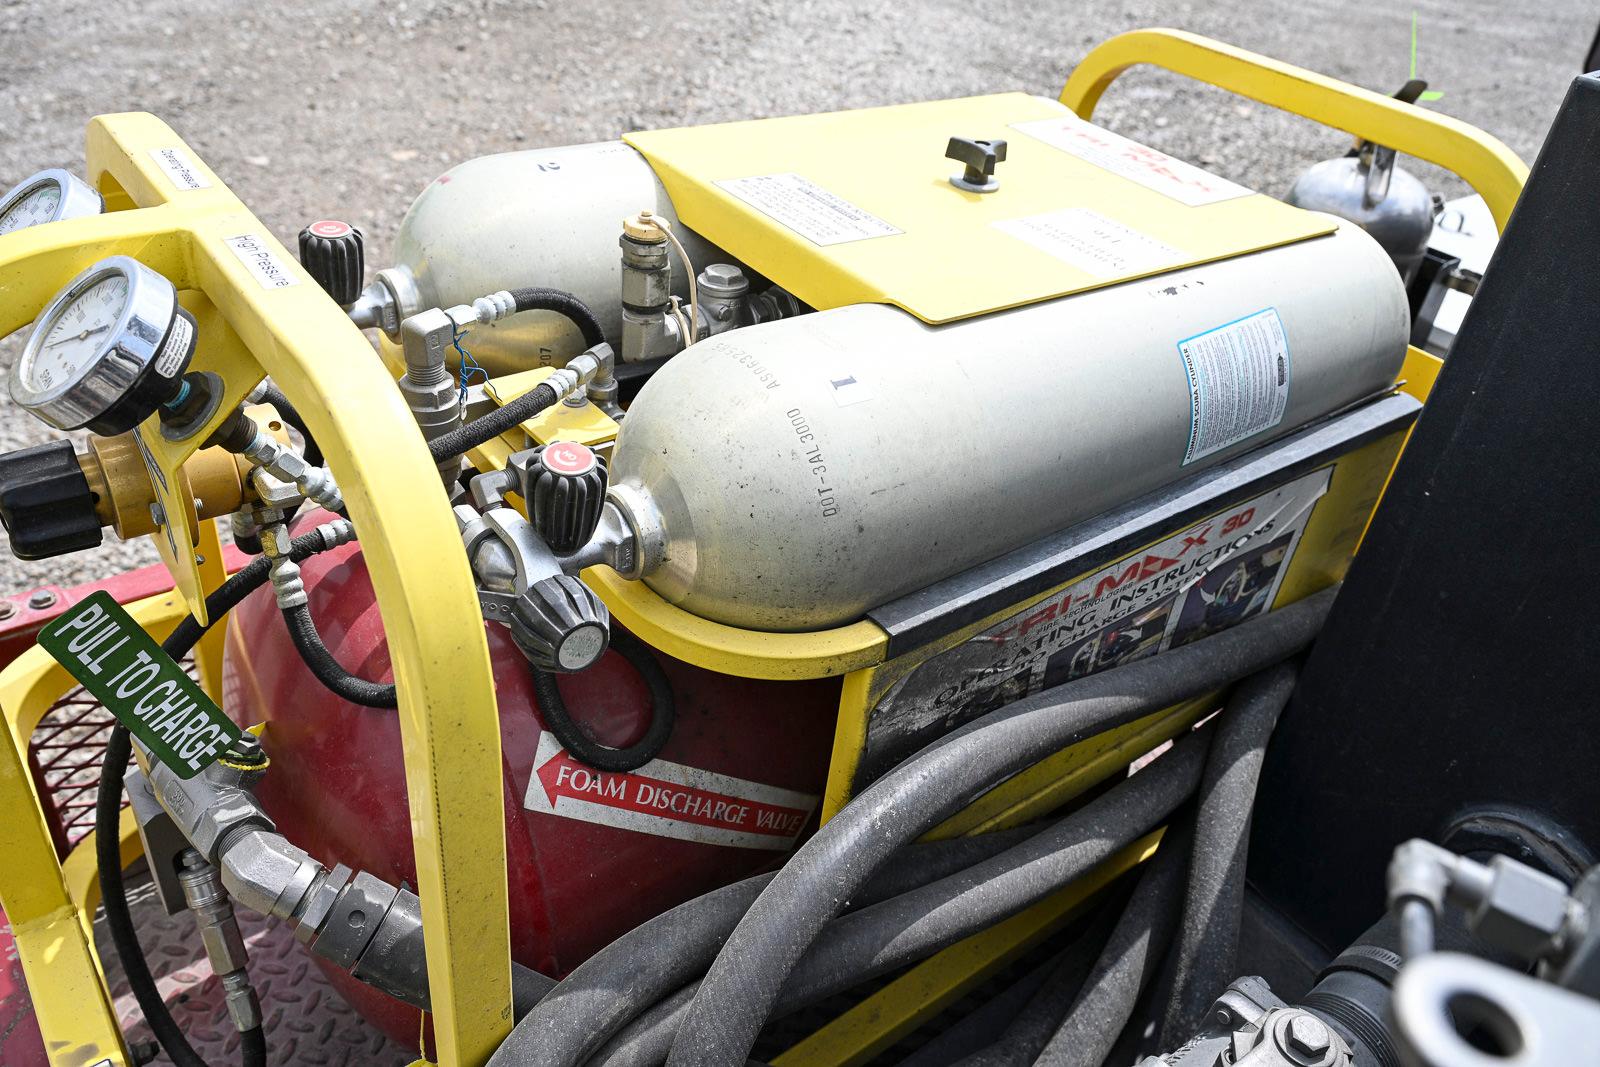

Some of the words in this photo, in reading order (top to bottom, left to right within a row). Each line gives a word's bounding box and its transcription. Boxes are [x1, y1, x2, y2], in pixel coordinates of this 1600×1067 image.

[160, 149, 184, 170] Operating
[180, 168, 200, 188] Pressure
[234, 234, 260, 253] High
[250, 252, 289, 287] Pressure
[830, 375, 857, 390] 1
[1183, 347, 1198, 388] CYLINDER
[786, 408, 814, 444] 3000
[1186, 418, 1199, 460] ALUMINUM
[1220, 507, 1256, 537] 30
[1110, 518, 1276, 611] INSTRUCTIONS
[1063, 581, 1134, 620] TECHNOLOGIES
[1058, 603, 1136, 648] CHARGE
[54, 603, 131, 675] PULL
[105, 650, 160, 699] TO
[133, 680, 232, 770] CHARGE
[556, 765, 628, 800] FOAM
[635, 784, 750, 826] DISCHARGE
[756, 810, 803, 832] VALVE
